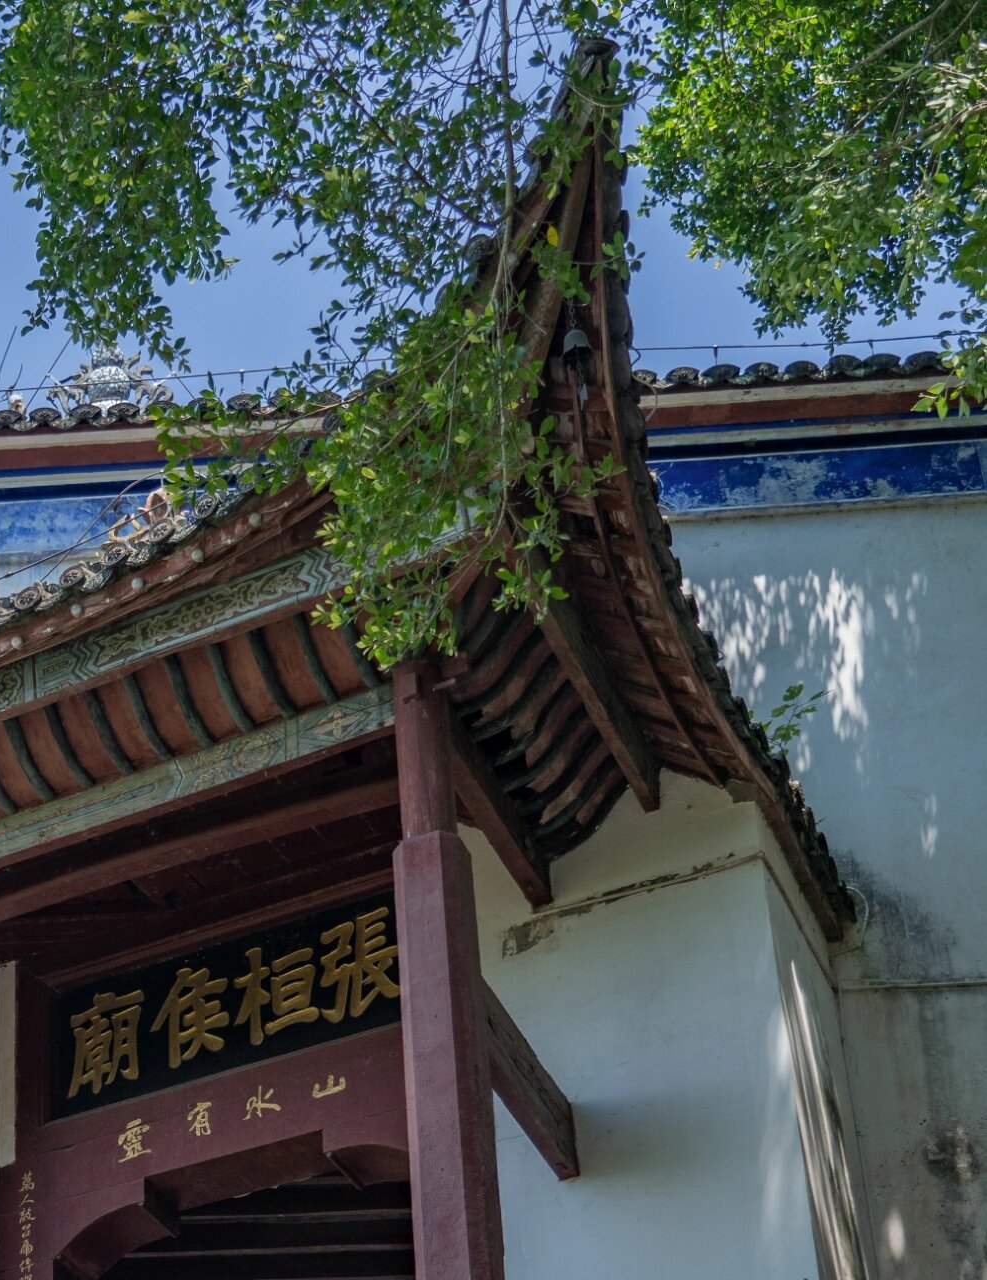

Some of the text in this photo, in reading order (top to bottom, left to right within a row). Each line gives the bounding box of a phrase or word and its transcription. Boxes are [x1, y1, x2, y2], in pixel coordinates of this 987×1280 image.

[67, 906, 401, 1099] 張桓侯廟
[117, 1074, 347, 1164] 山水有靈
